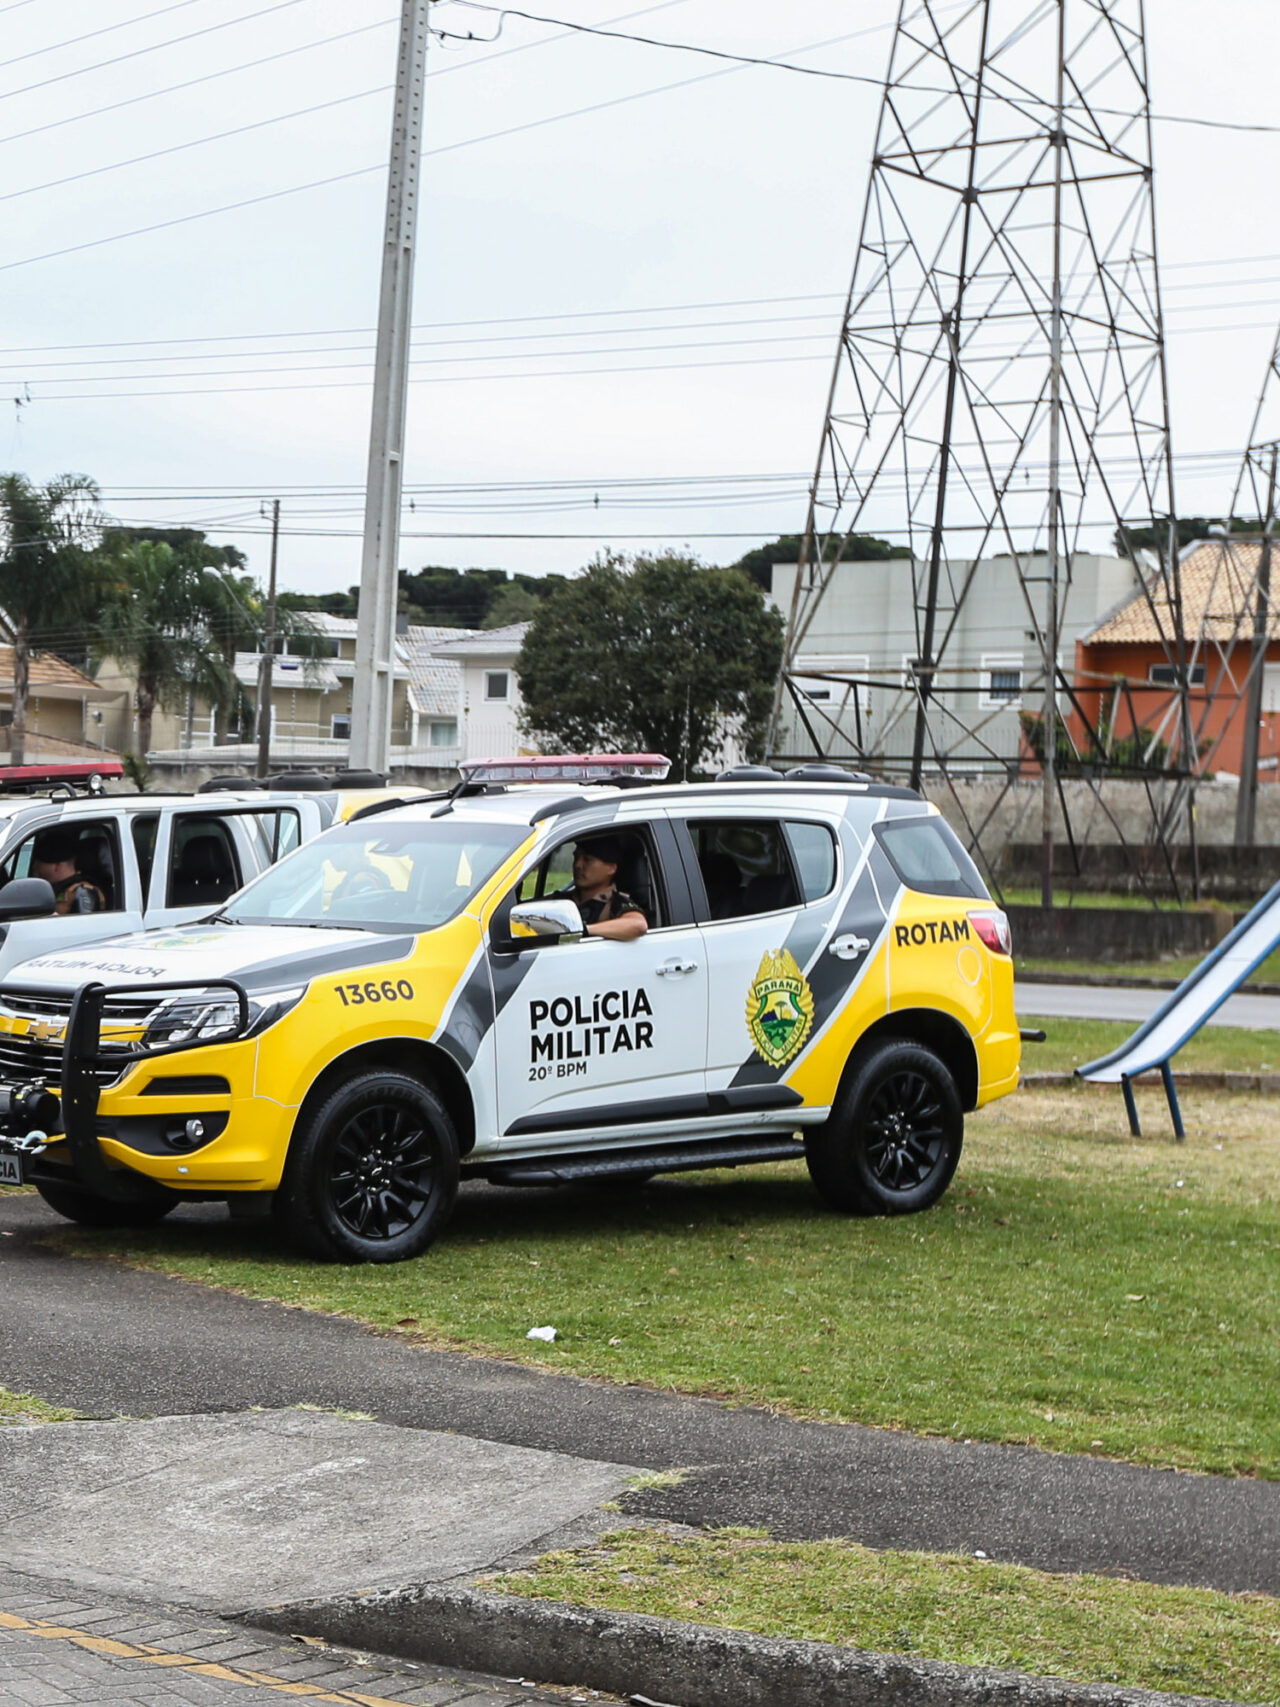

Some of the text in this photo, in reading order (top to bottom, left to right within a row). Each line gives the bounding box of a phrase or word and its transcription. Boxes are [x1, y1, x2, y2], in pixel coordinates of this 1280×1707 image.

[895, 919, 970, 947] ROTAM
[334, 979, 414, 1006] 13660
[757, 980, 800, 996] PARANÁ
[529, 988, 653, 1030] POLÍCIA
[531, 1021, 654, 1063] MILITAR
[557, 1061, 587, 1078] BPM
